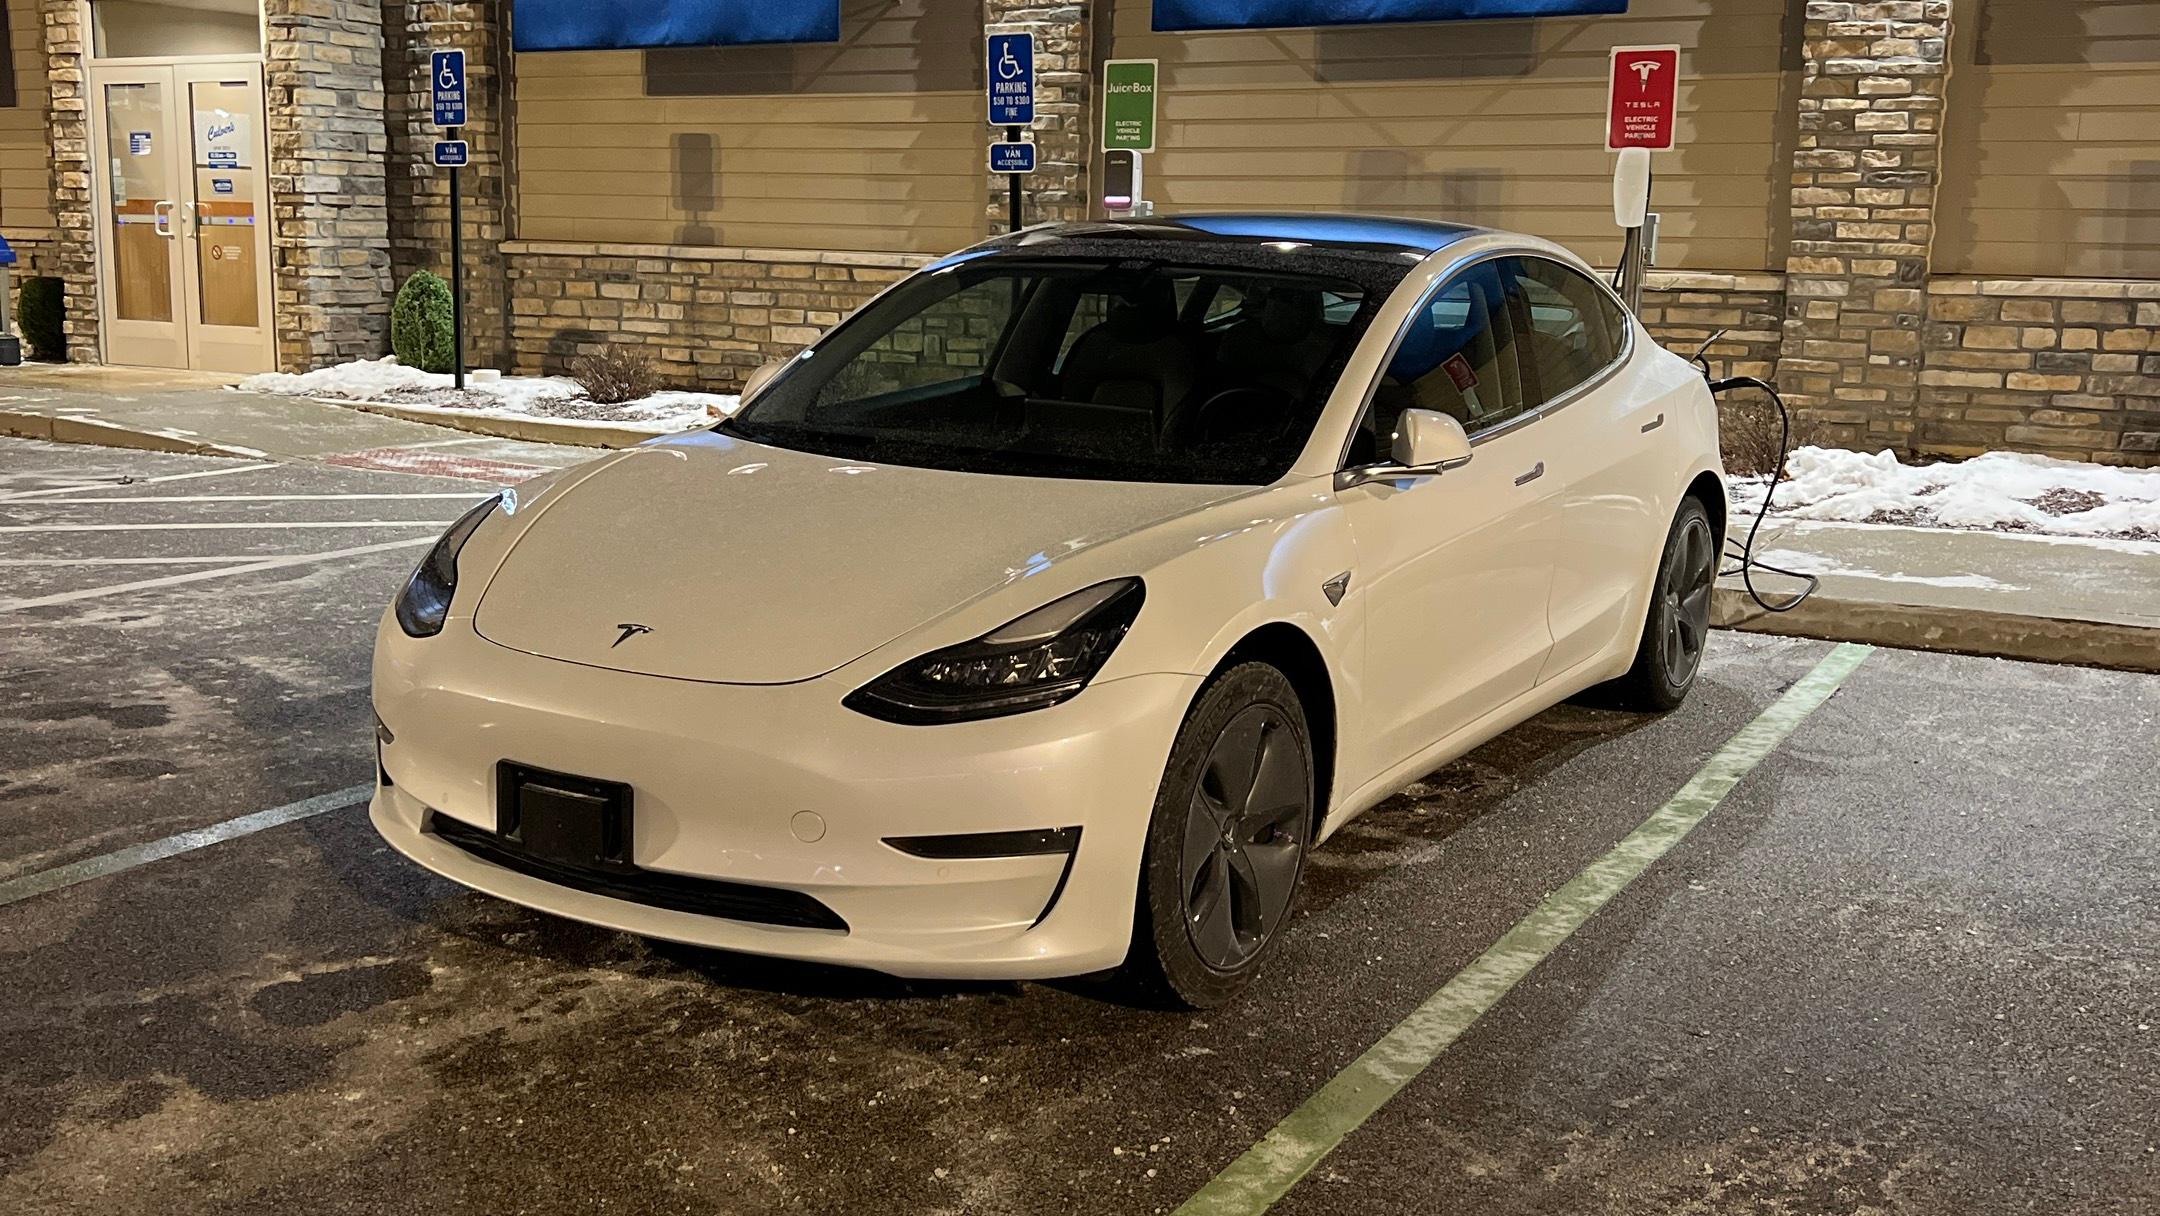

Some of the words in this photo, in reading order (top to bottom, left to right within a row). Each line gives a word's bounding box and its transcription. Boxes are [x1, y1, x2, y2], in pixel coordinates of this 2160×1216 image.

[996, 82, 1027, 94] PARKING
[1006, 96, 1013, 105] TO
[1005, 107, 1018, 116] FINE
[1005, 149, 1021, 158] VAN
